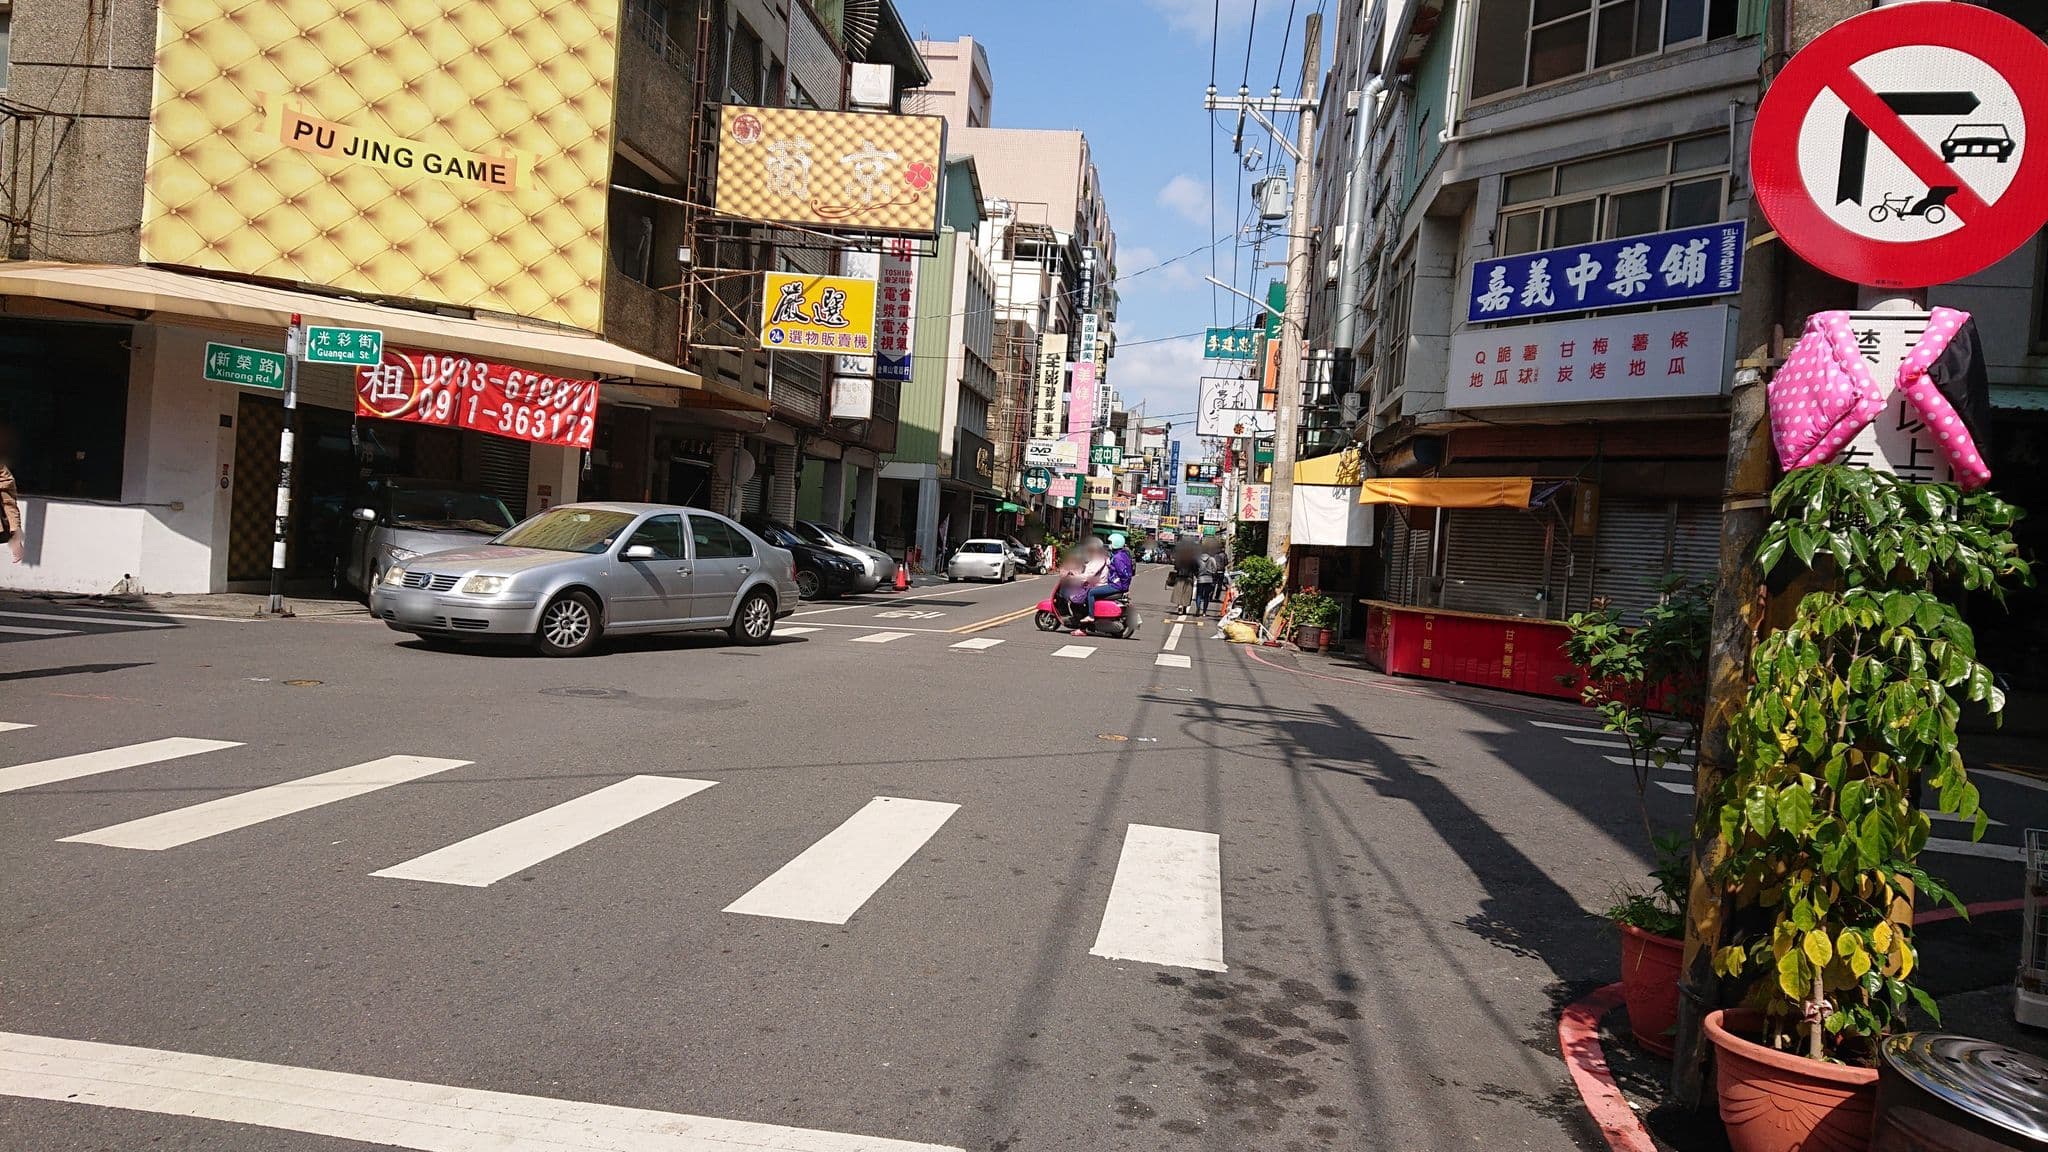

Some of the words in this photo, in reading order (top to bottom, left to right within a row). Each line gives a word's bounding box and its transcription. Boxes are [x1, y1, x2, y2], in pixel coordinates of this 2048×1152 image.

[293, 119, 336, 150] PU
[342, 136, 414, 169] JING
[422, 152, 507, 185] GAME
[885, 269, 913, 277] TOSHIBA
[881, 286, 897, 351] 電漿電視
[896, 287, 912, 351] 省電冷氣
[317, 331, 373, 349] 光彩街
[789, 329, 868, 349] 選物販賣機
[1560, 330, 1690, 358] 甘梅薯條
[216, 350, 275, 374] 新榮路
[317, 347, 355, 362] Guangcai
[216, 368, 254, 383] Xinrong
[255, 373, 272, 384] Rd.
[359, 362, 410, 405] 租
[1469, 367, 1534, 388] 地瓜球
[1557, 356, 1686, 383] 炭烤地瓜
[1029, 446, 1052, 454] DVD
[1241, 486, 1259, 520] 素食
